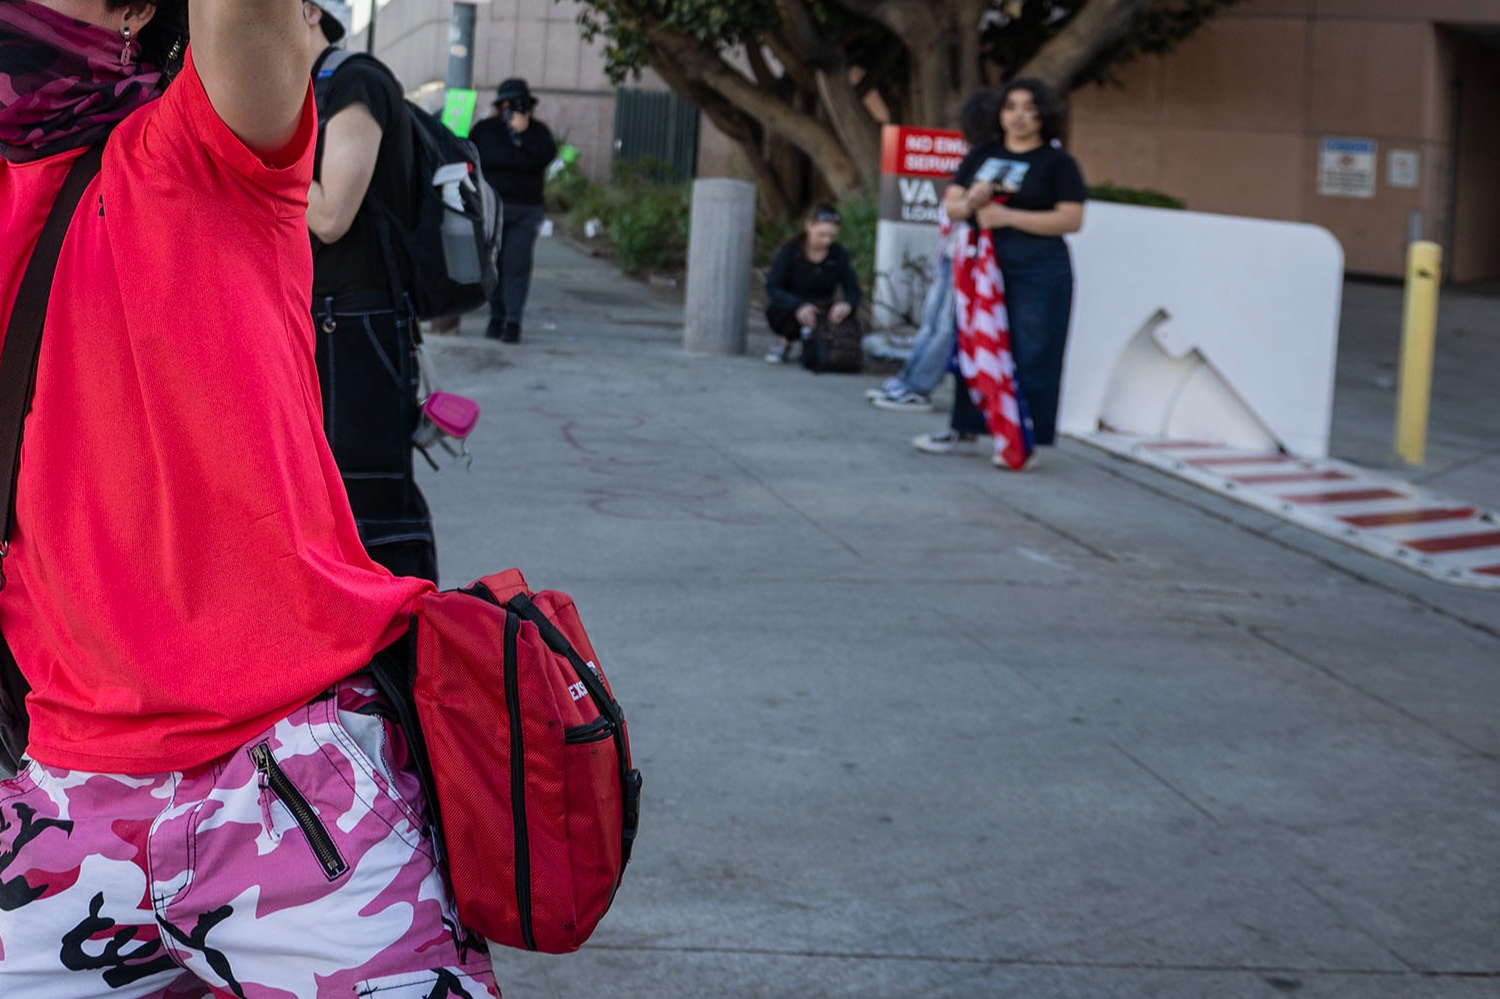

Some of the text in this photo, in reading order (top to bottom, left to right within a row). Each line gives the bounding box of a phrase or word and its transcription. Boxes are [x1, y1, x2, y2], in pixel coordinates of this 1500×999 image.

[905, 134, 933, 153] NO
[898, 178, 939, 205] VA
[568, 681, 588, 701] EXS
